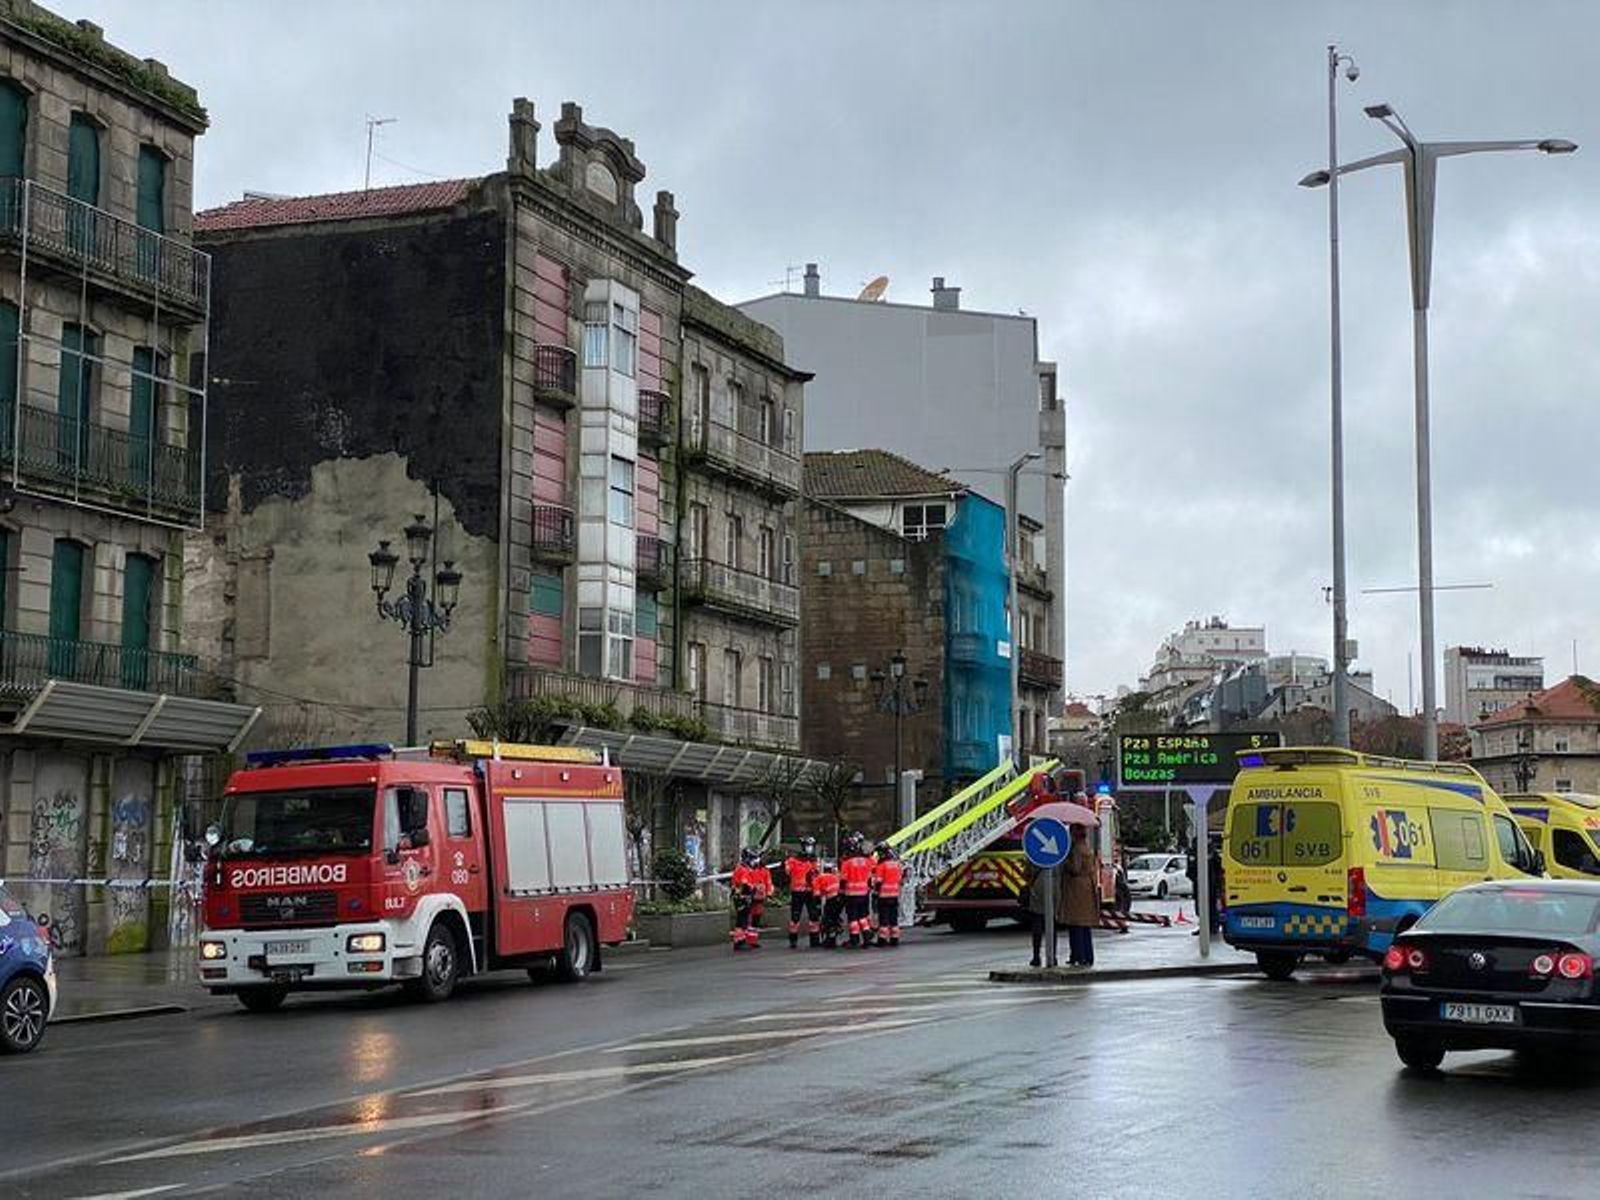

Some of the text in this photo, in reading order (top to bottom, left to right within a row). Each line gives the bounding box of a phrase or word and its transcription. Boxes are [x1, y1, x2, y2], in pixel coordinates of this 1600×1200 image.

[1123, 737, 1150, 749] Pza
[1124, 751, 1218, 764] Pza América
[1124, 769, 1176, 780] Bouzas
[1247, 788, 1322, 800] AMBULANCIA
[1399, 821, 1427, 847] 061
[1240, 841, 1331, 859] 061 SVB
[450, 868, 469, 884] 080
[266, 896, 308, 907] MAN
[1448, 1004, 1481, 1019] 7911
